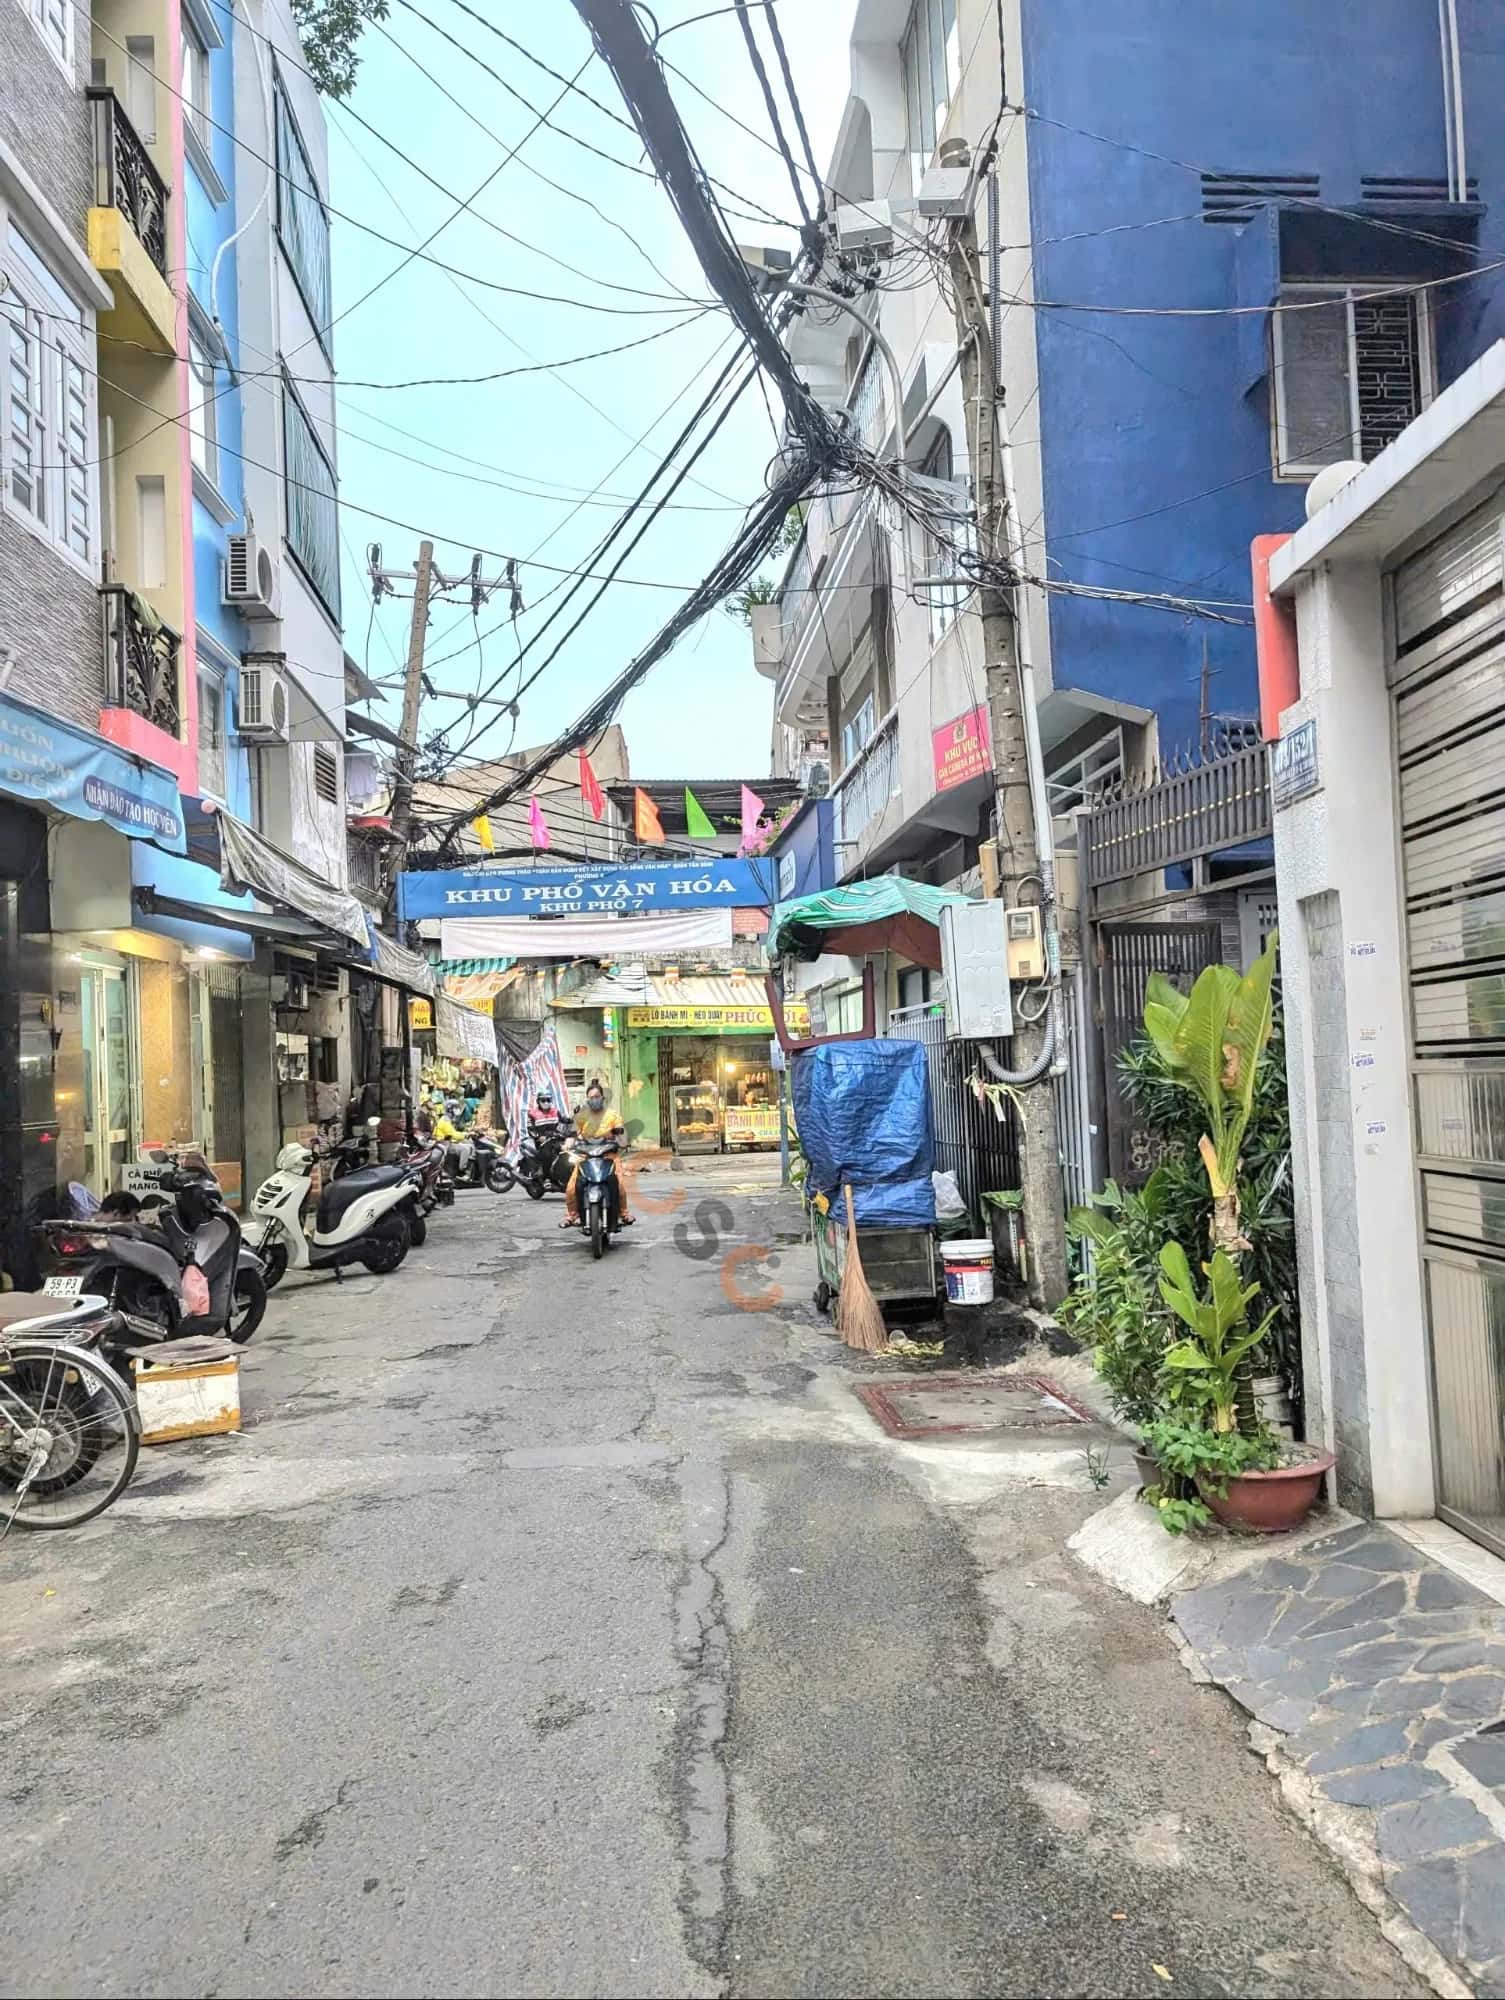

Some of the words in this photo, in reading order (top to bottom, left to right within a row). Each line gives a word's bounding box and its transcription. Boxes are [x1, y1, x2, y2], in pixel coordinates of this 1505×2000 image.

[445, 888, 513, 904] KHU
[521, 879, 584, 901] PHỐ
[590, 879, 657, 899] VĂN
[669, 874, 736, 895] HÓA
[539, 901, 582, 913] KHU
[588, 895, 627, 911] PHỐ
[631, 900, 644, 909] 7
[724, 1008, 767, 1024] PHÚC
[127, 1167, 142, 1179] CÀ
[128, 1182, 159, 1191] MANG
